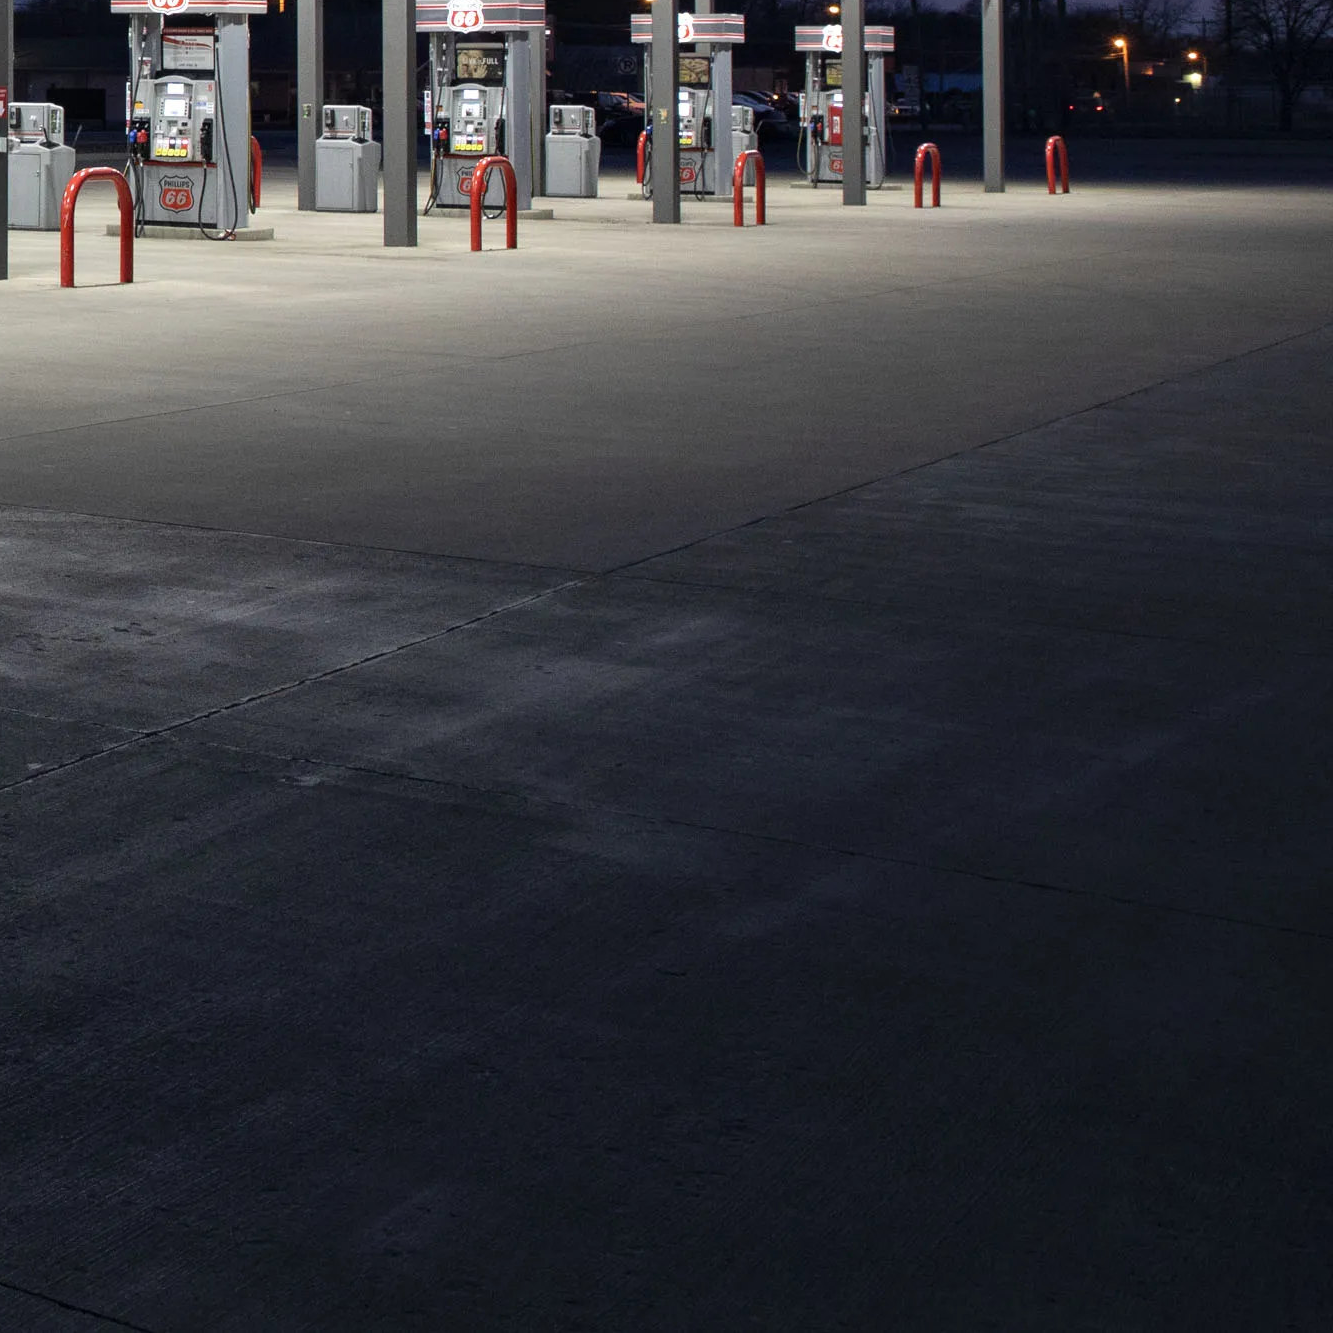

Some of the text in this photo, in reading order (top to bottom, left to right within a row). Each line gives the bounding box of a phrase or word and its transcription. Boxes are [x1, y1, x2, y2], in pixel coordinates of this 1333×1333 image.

[453, 11, 477, 27] 66
[482, 57, 499, 65] FULL
[163, 179, 190, 188] PHILLIPS
[165, 191, 188, 205] 66
